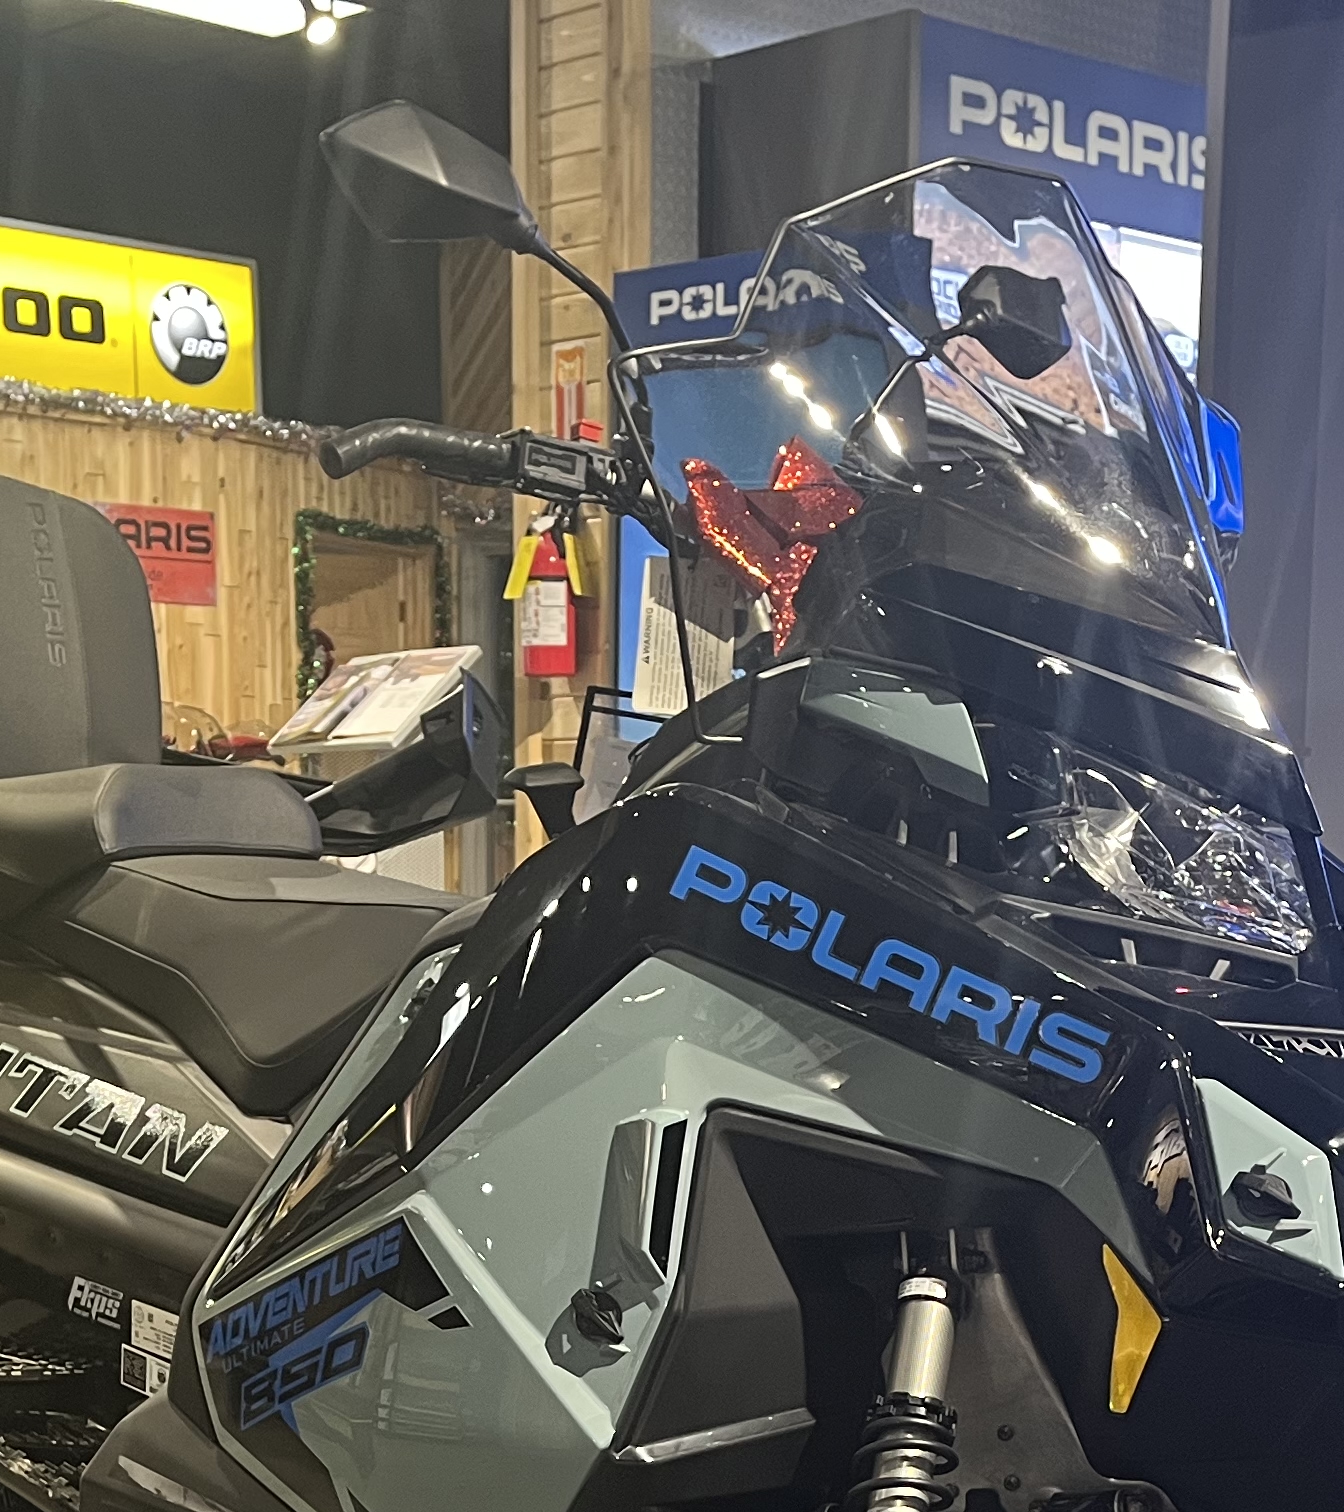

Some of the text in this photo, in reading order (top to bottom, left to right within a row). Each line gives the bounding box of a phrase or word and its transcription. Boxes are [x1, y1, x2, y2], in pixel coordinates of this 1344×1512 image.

[181, 337, 227, 360] BRP
[114, 517, 213, 554] ARIS
[669, 844, 1112, 1085] POLARIS
[206, 1223, 403, 1364] ADVENTURE
[221, 1316, 306, 1374] ULTIMATE
[240, 1320, 371, 1431] 850
